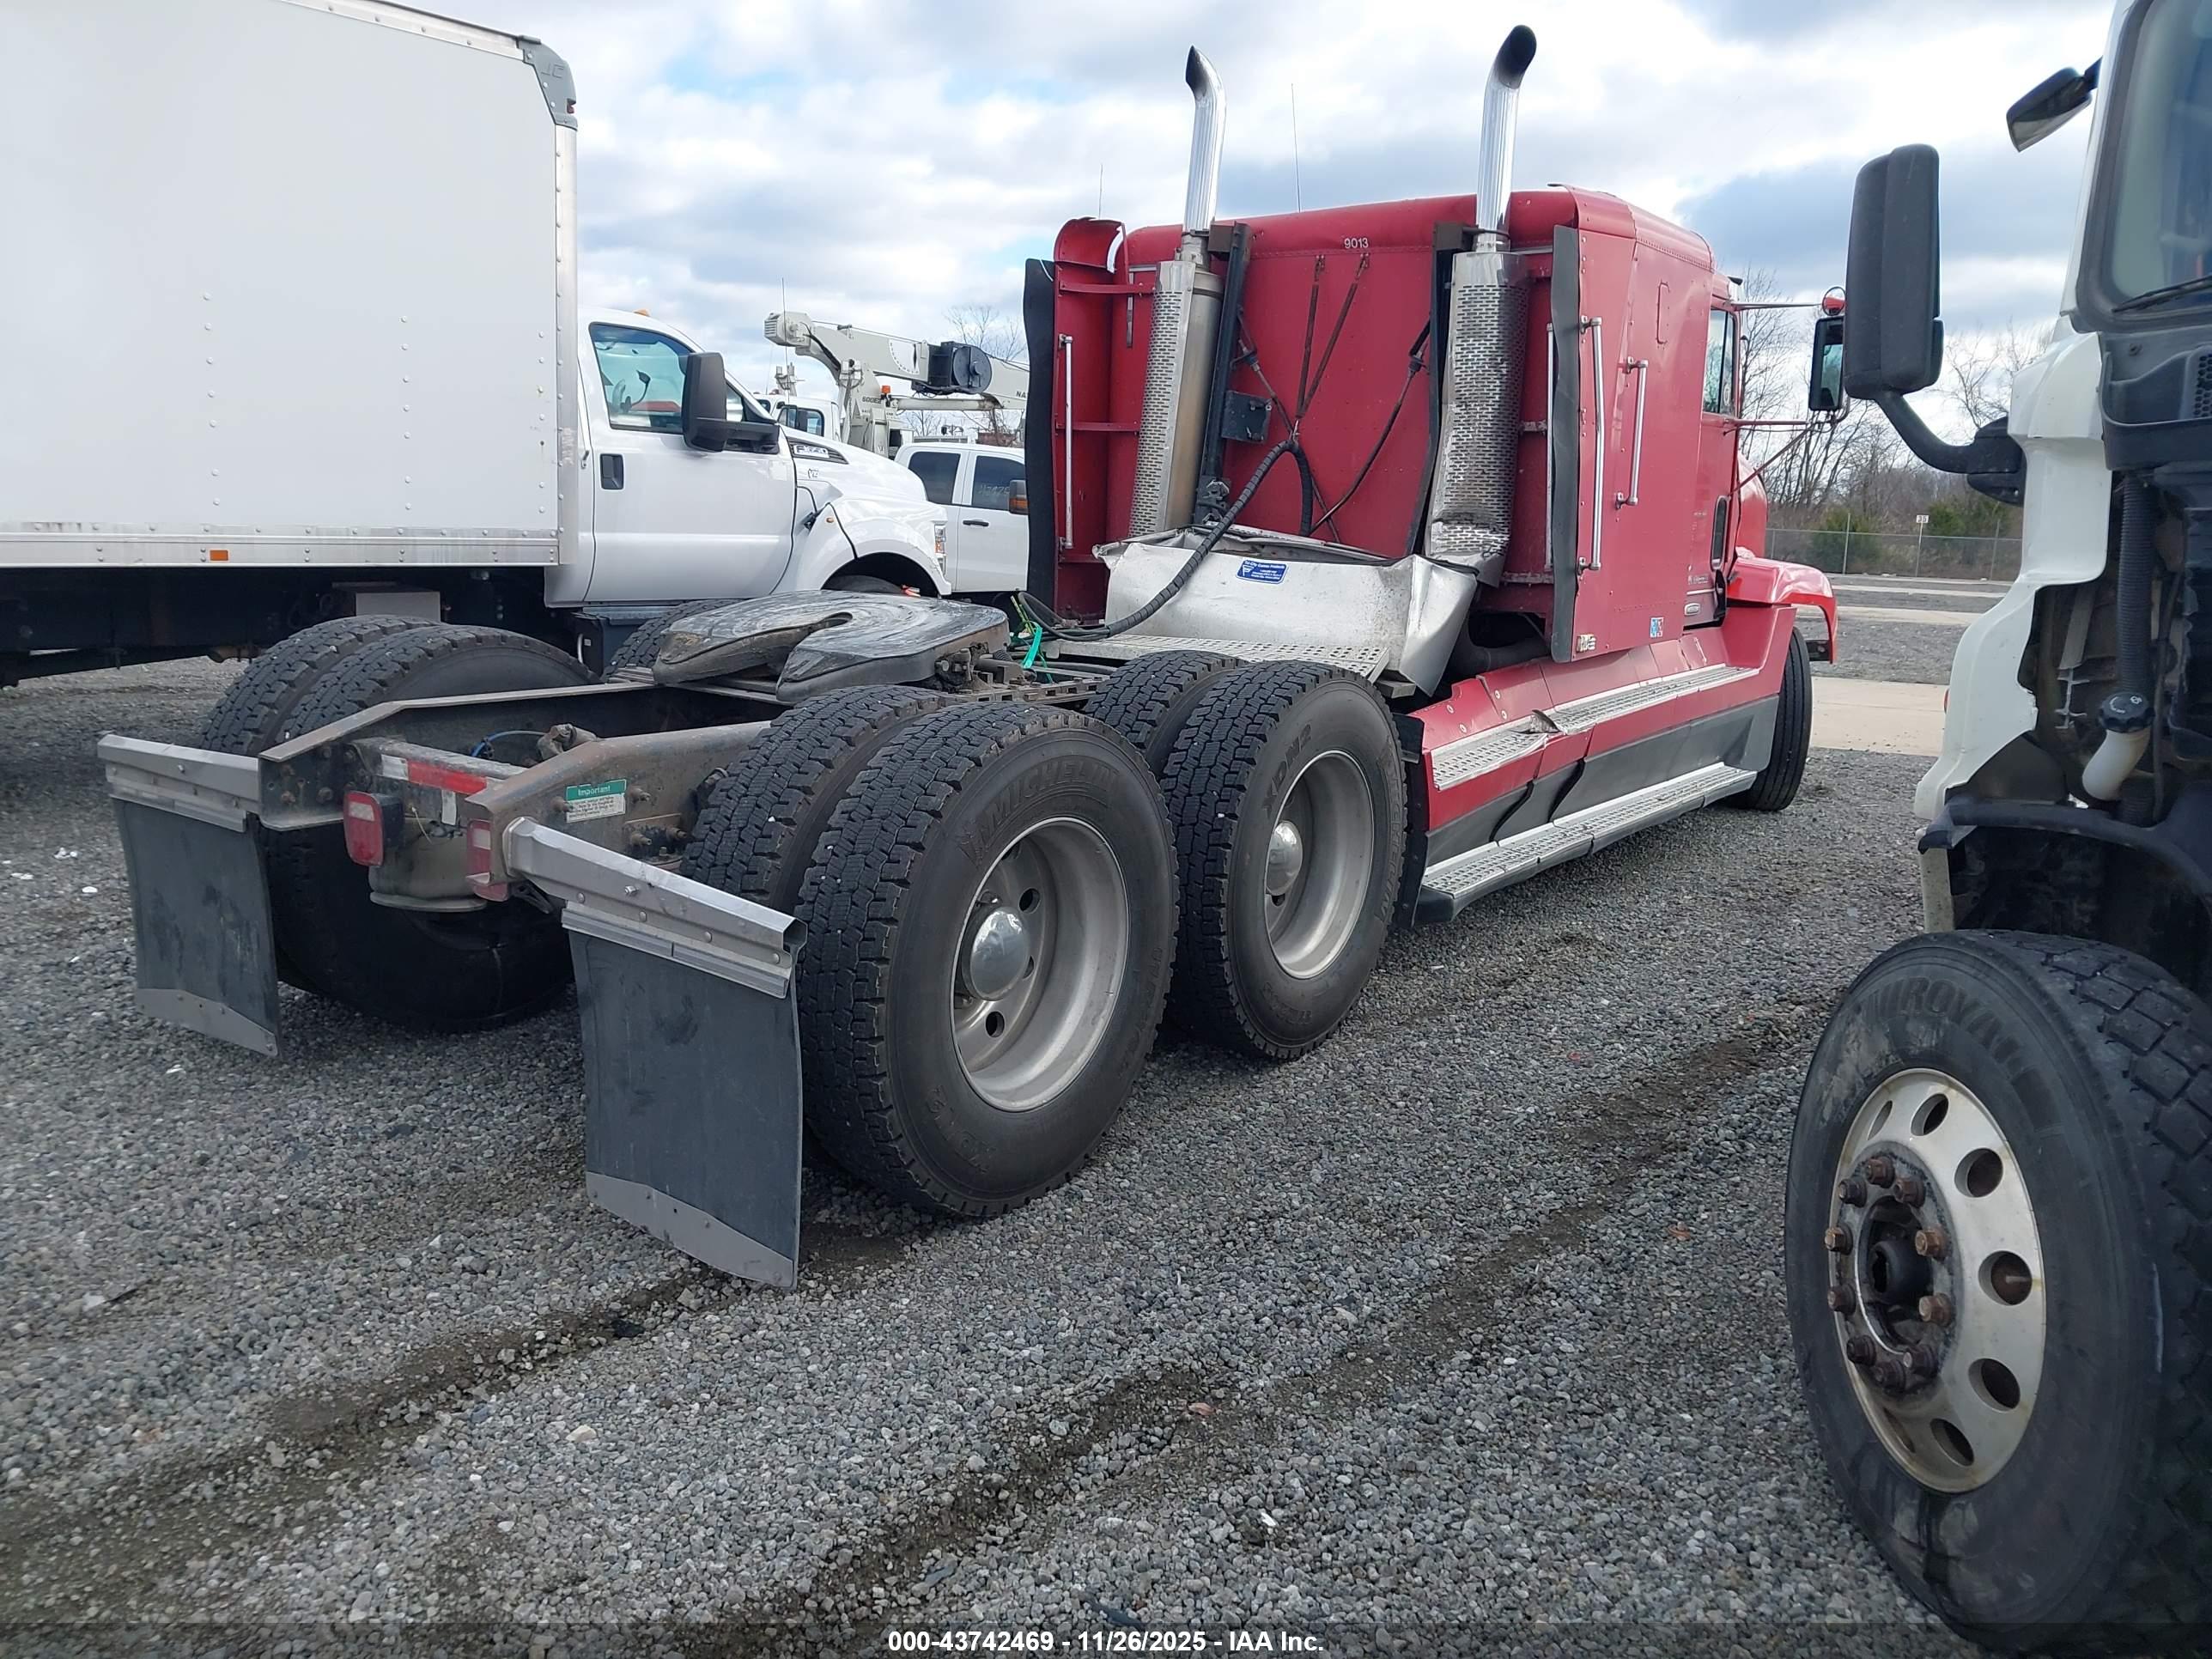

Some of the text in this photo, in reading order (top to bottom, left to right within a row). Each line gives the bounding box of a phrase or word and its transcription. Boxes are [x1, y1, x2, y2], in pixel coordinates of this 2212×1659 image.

[1344, 237, 1369, 249] 9013
[578, 785, 611, 797] Important
[990, 756, 1117, 828] MICHELIN
